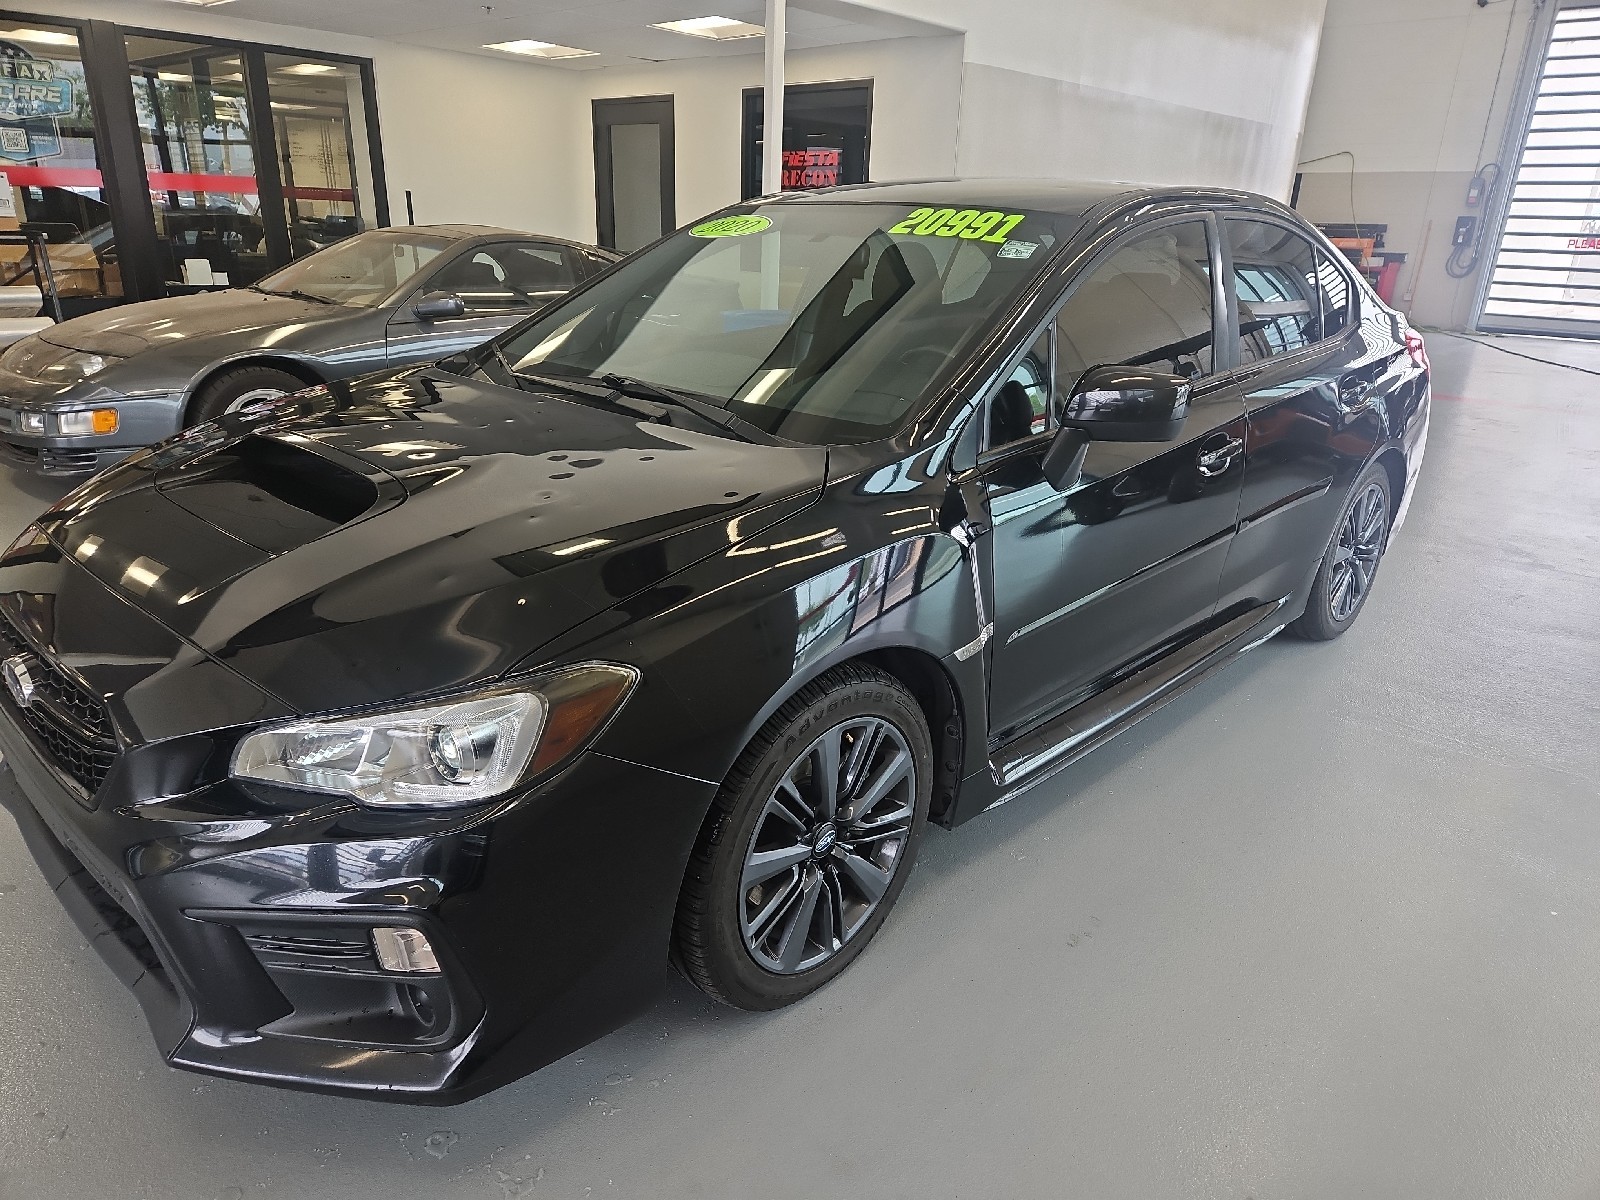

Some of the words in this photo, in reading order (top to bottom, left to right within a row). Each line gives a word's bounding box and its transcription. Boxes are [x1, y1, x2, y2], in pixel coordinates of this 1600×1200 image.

[781, 150, 839, 167] FIESTA
[781, 169, 837, 188] RECON
[888, 207, 1026, 243] 20991
